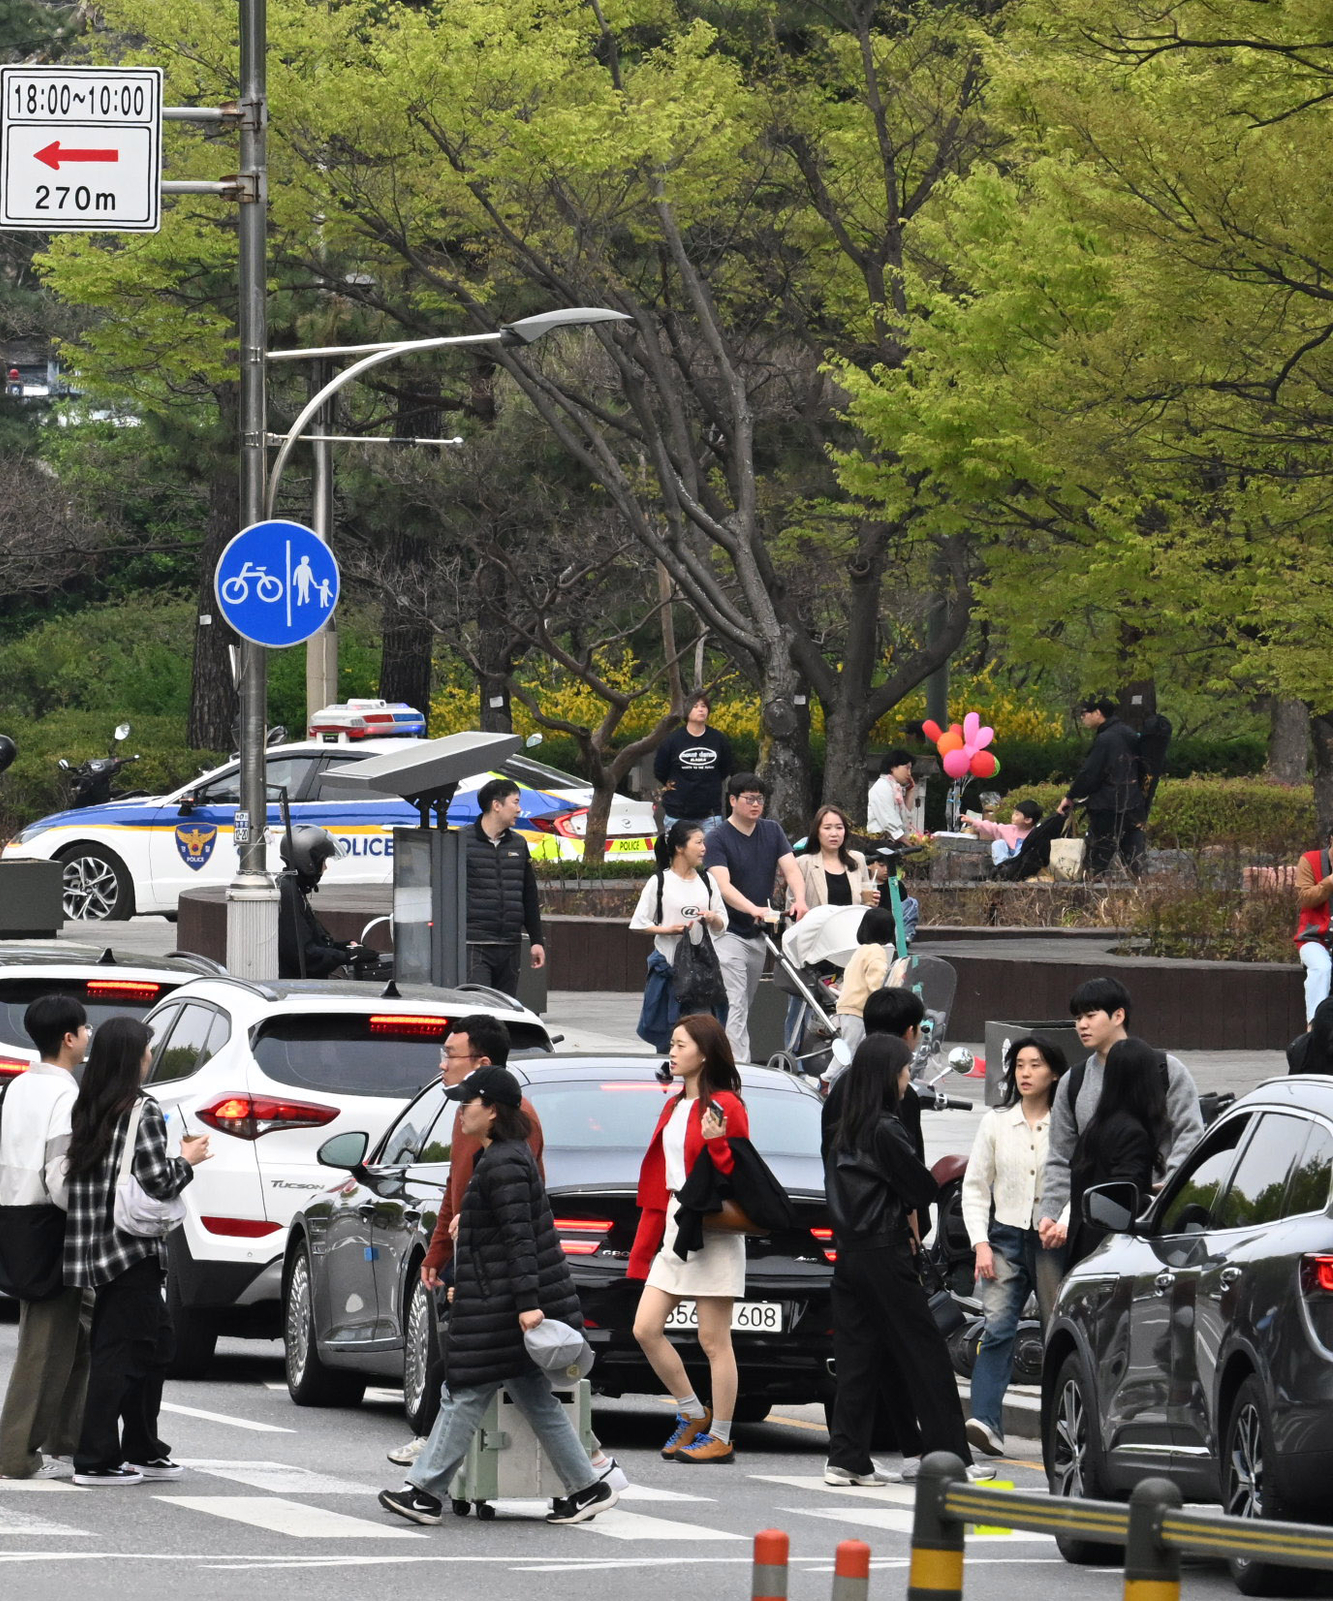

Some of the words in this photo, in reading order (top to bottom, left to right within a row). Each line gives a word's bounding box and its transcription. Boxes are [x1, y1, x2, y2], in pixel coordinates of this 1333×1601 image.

[14, 83, 144, 116] 18:00~10:00
[35, 185, 116, 211] 270m
[619, 840, 640, 851] POLICE
[737, 1306, 776, 1327] 608
